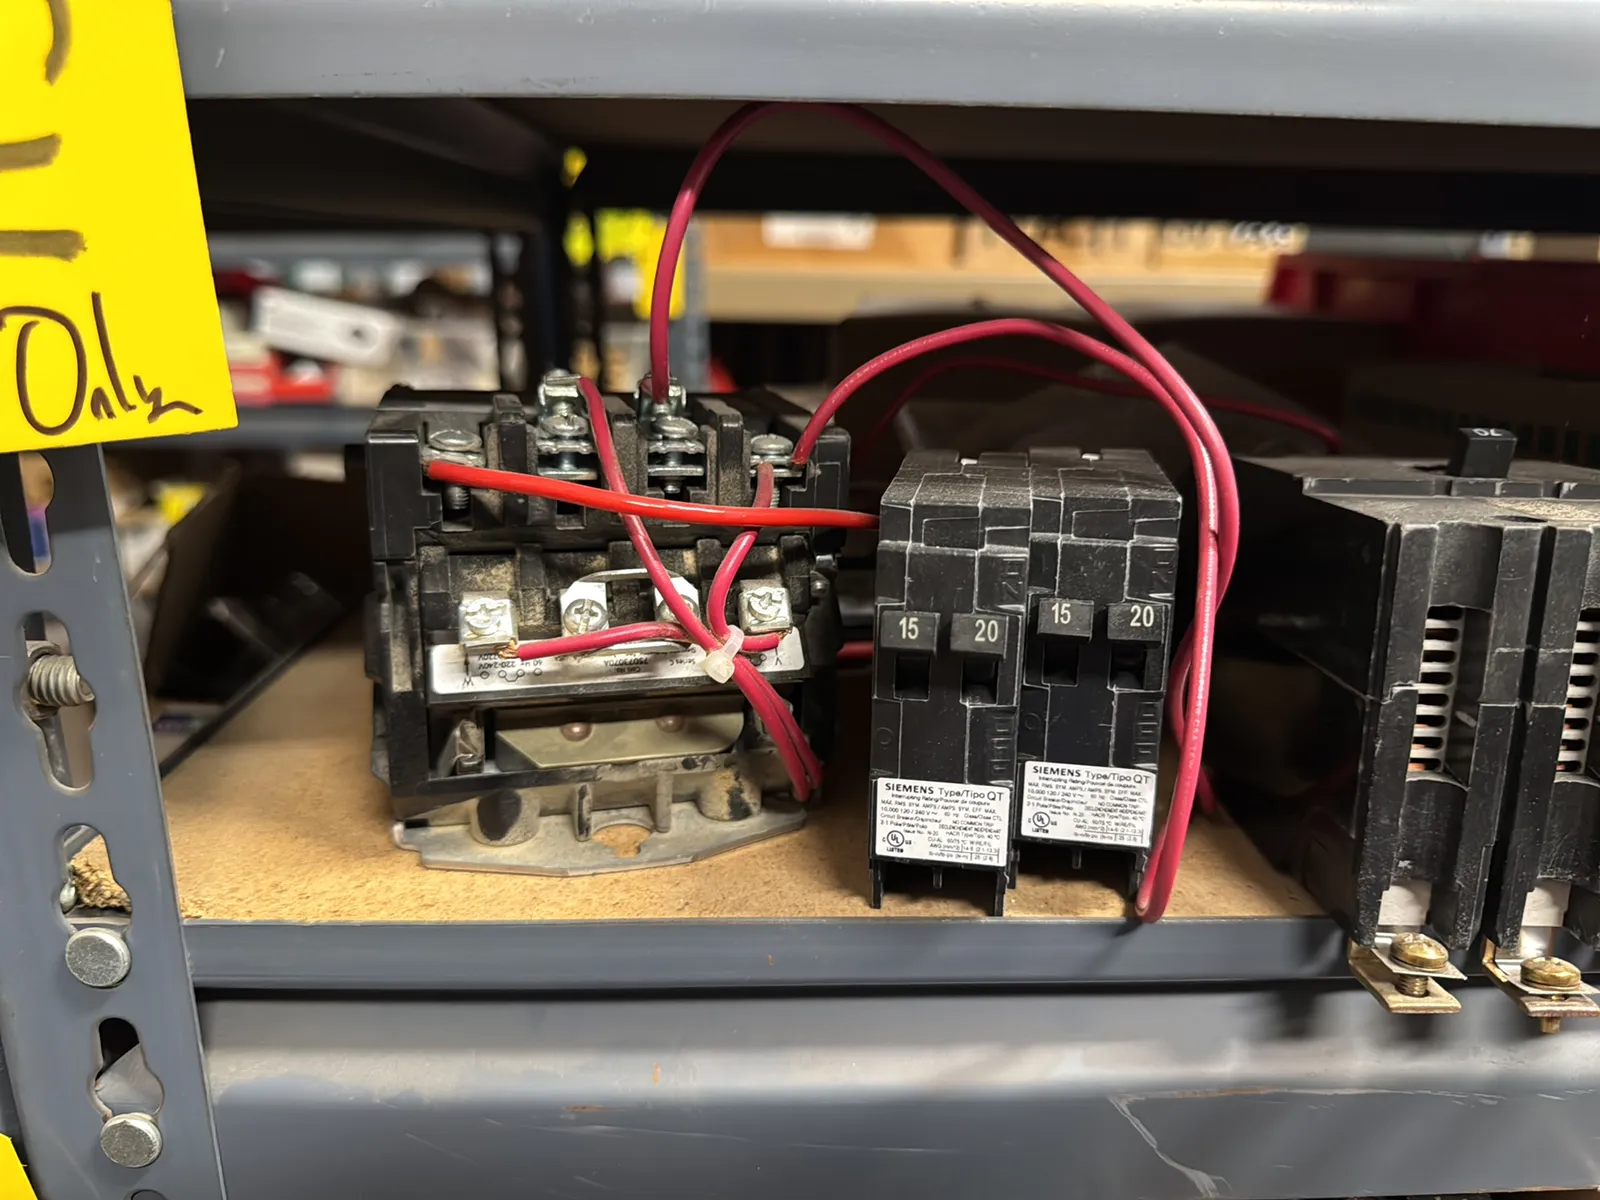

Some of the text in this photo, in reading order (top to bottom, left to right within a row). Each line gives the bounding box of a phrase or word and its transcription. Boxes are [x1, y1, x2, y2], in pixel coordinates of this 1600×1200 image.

[0, 291, 204, 435] Only
[1051, 603, 1071, 624] 15
[1130, 605, 1154, 627] 20
[899, 617, 919, 639] 15
[975, 619, 999, 642] 20
[1032, 765, 1149, 784] SIEMENS Type/Tipo QT
[885, 783, 1003, 801] SIEMENS Type/Tipo QT
